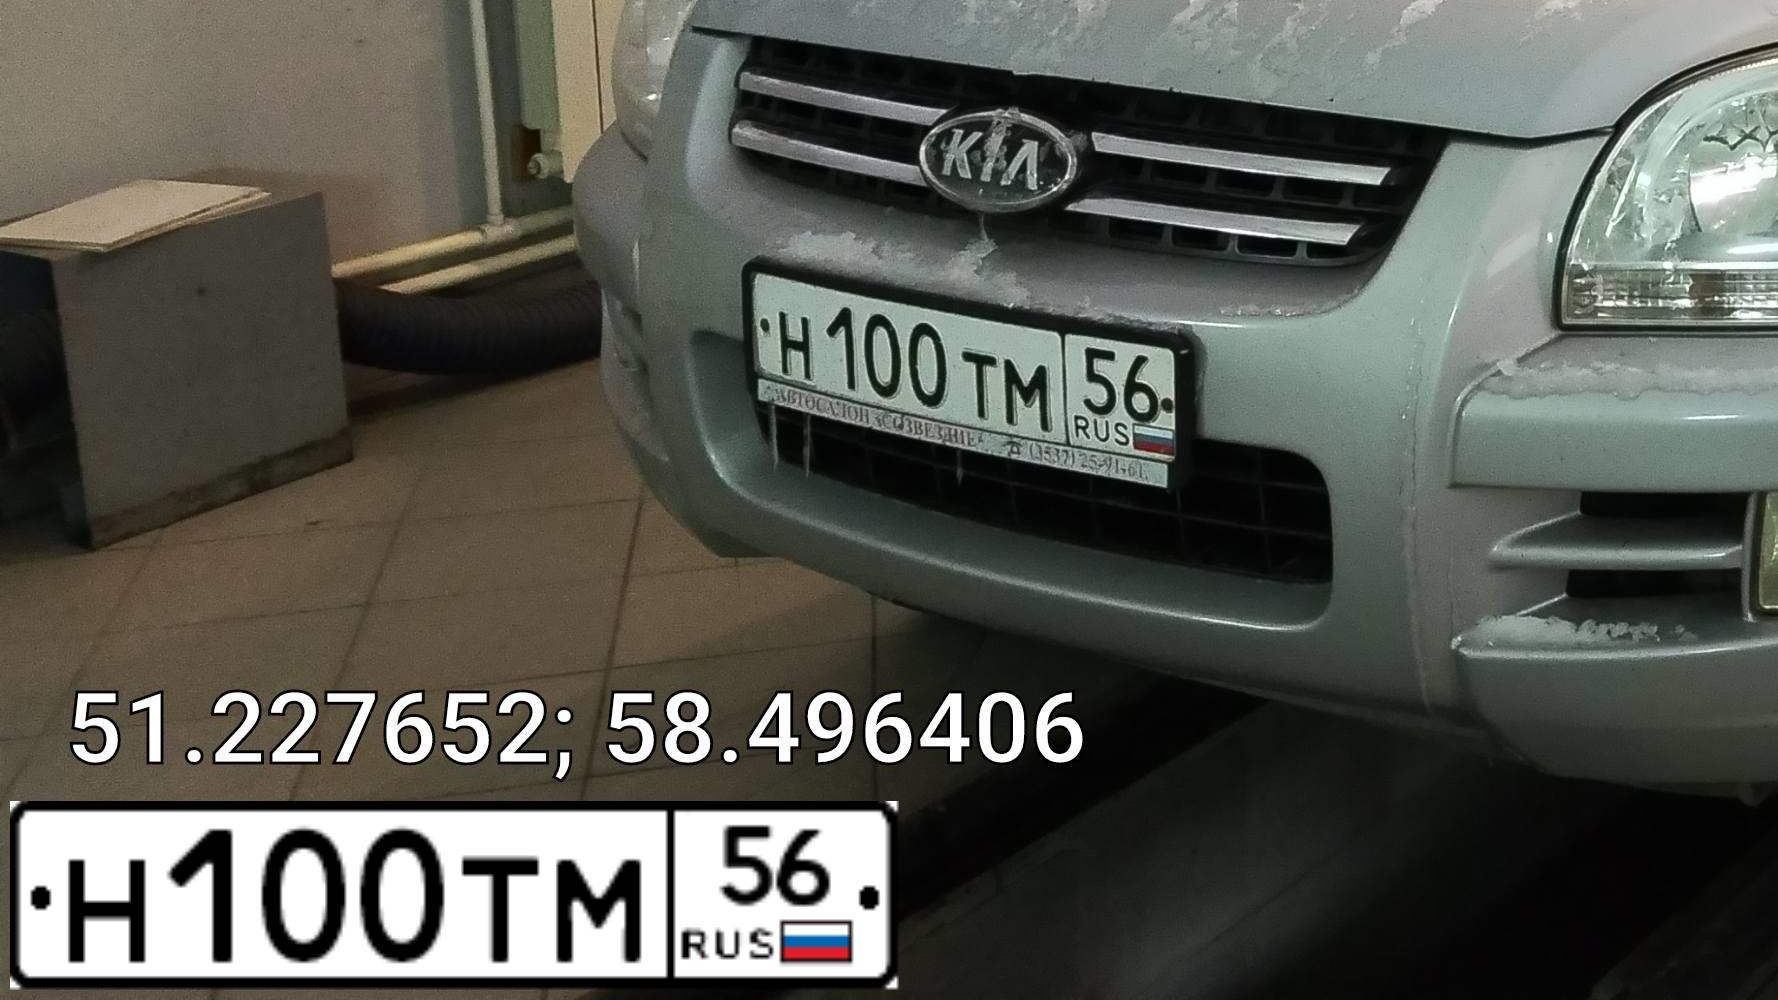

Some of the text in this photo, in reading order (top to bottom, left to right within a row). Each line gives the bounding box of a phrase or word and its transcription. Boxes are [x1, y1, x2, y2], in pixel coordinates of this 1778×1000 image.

[941, 127, 1039, 190] KIA
[773, 388, 870, 425] АВТОСАЛОН
[1082, 347, 1161, 423] 56
[1074, 414, 1131, 446] RUS
